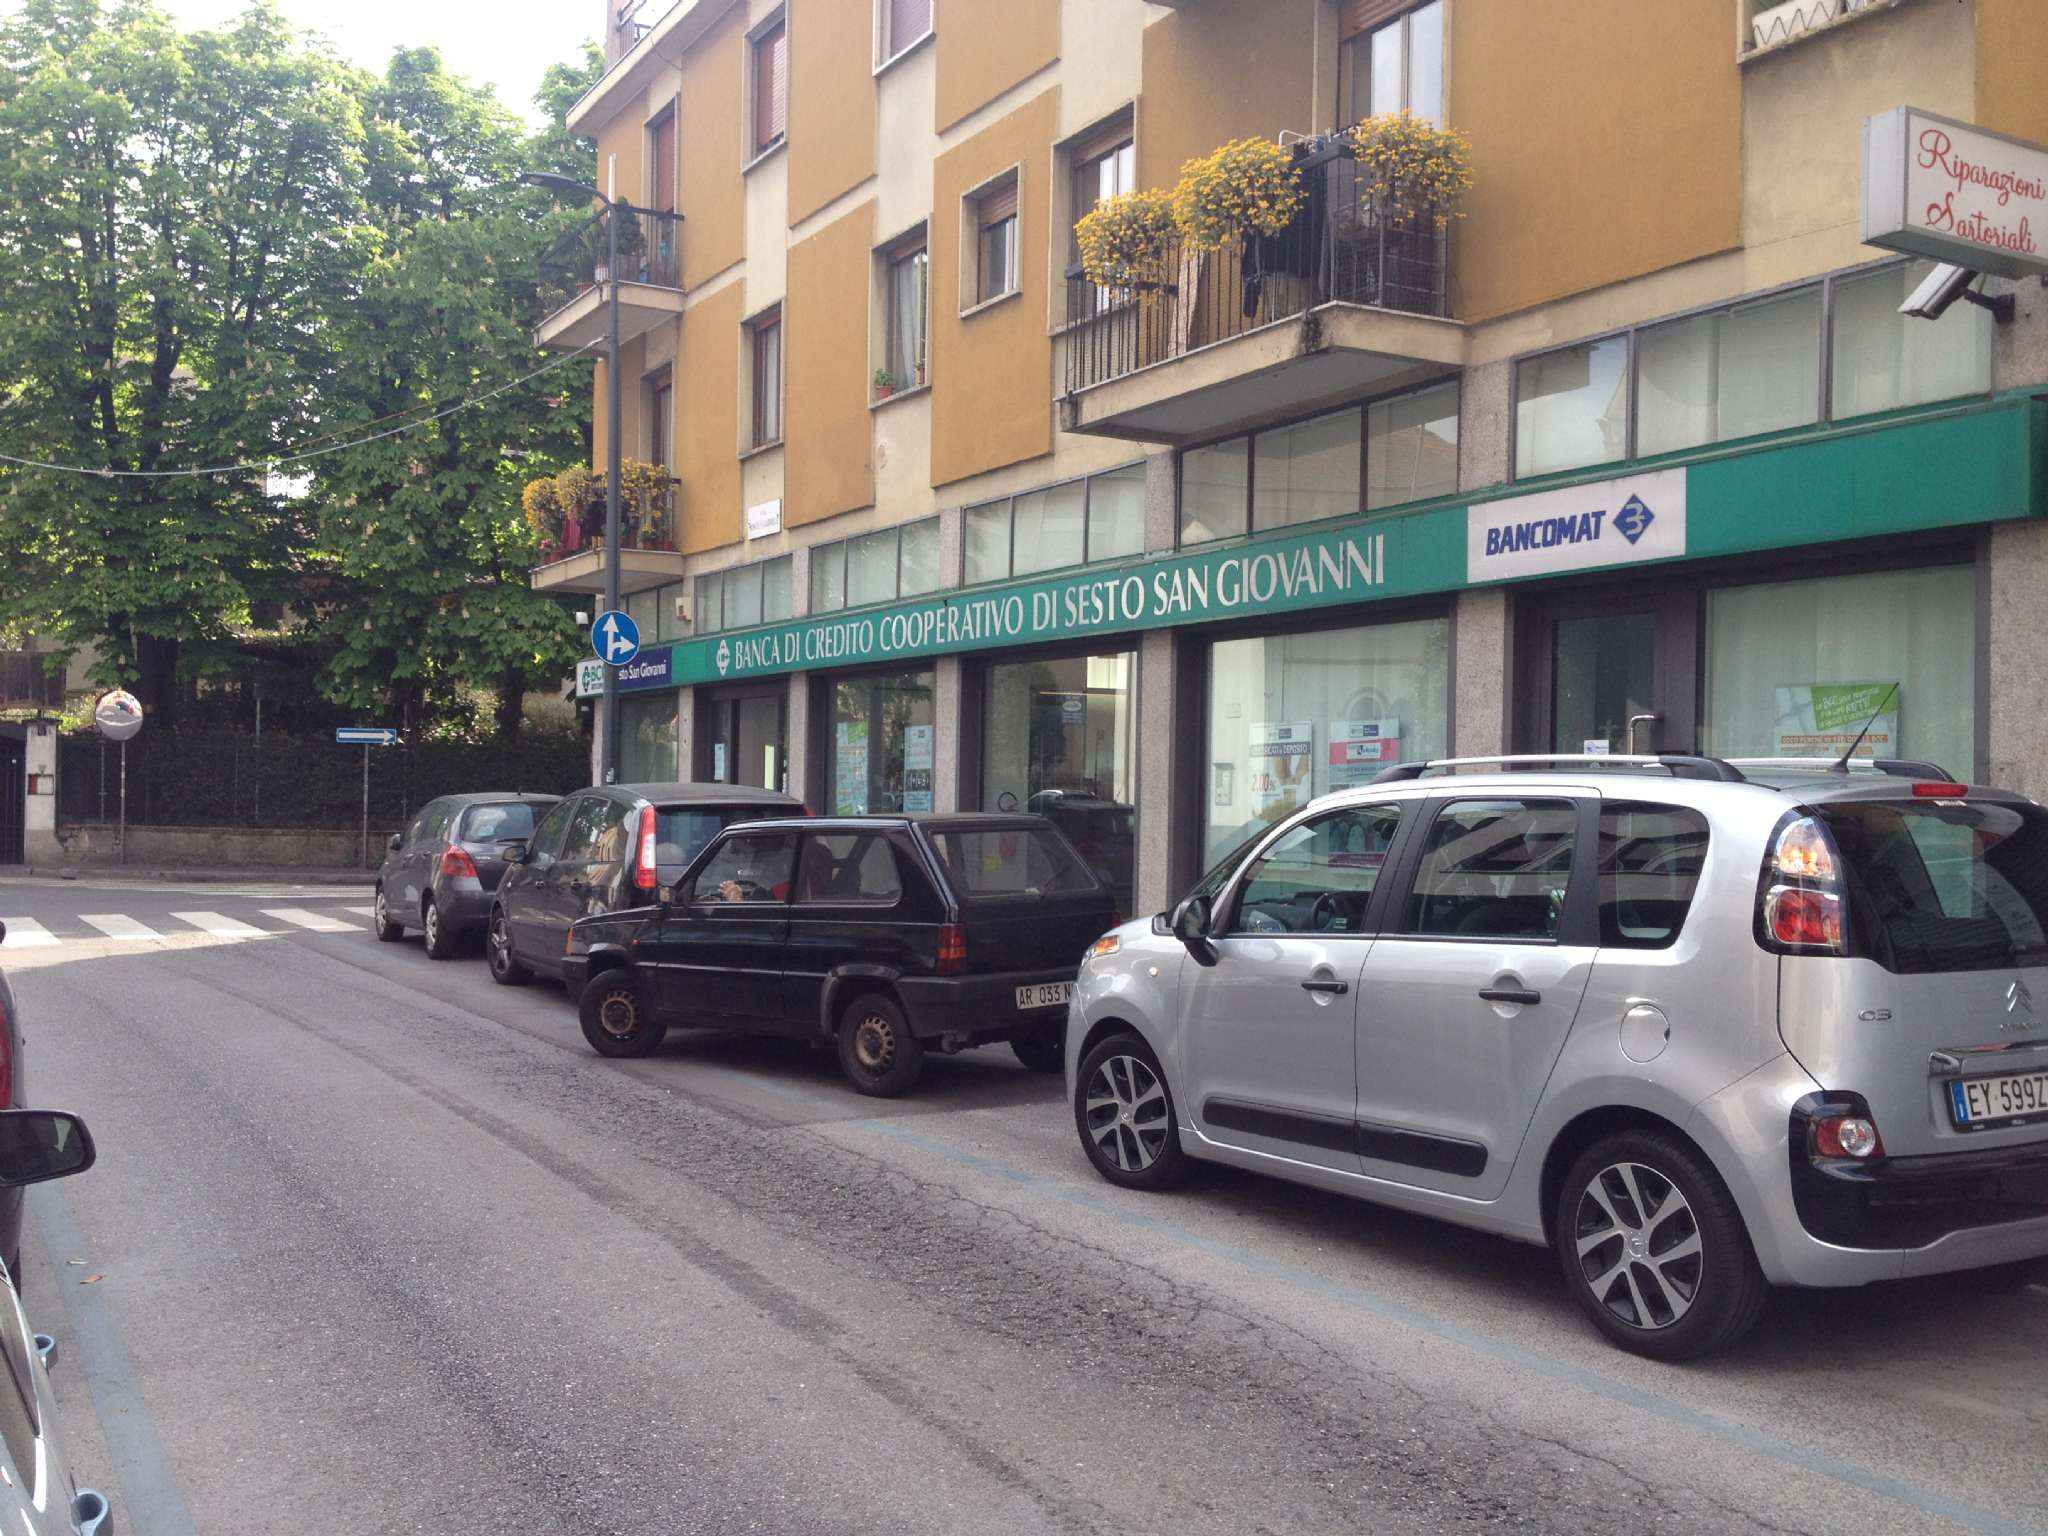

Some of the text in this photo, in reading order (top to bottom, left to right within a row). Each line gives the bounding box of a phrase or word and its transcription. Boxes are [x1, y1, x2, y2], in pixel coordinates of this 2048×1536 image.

[1918, 129, 2046, 206] Riparazioni
[1925, 191, 2037, 253] Sartoriali
[1485, 510, 1607, 555] BANCOMAT
[735, 534, 1385, 670] BANCA DI CREDITO COOPERATIVO DI SESTO SAN GIOVANNI
[590, 664, 602, 680] BC
[618, 660, 667, 680] sto San Giovanni
[1020, 983, 1072, 1006] AR 033 N
[1858, 1008, 1892, 1021] C3
[1967, 1082, 1991, 1116] EY
[2000, 1075, 2048, 1112] 599Z
